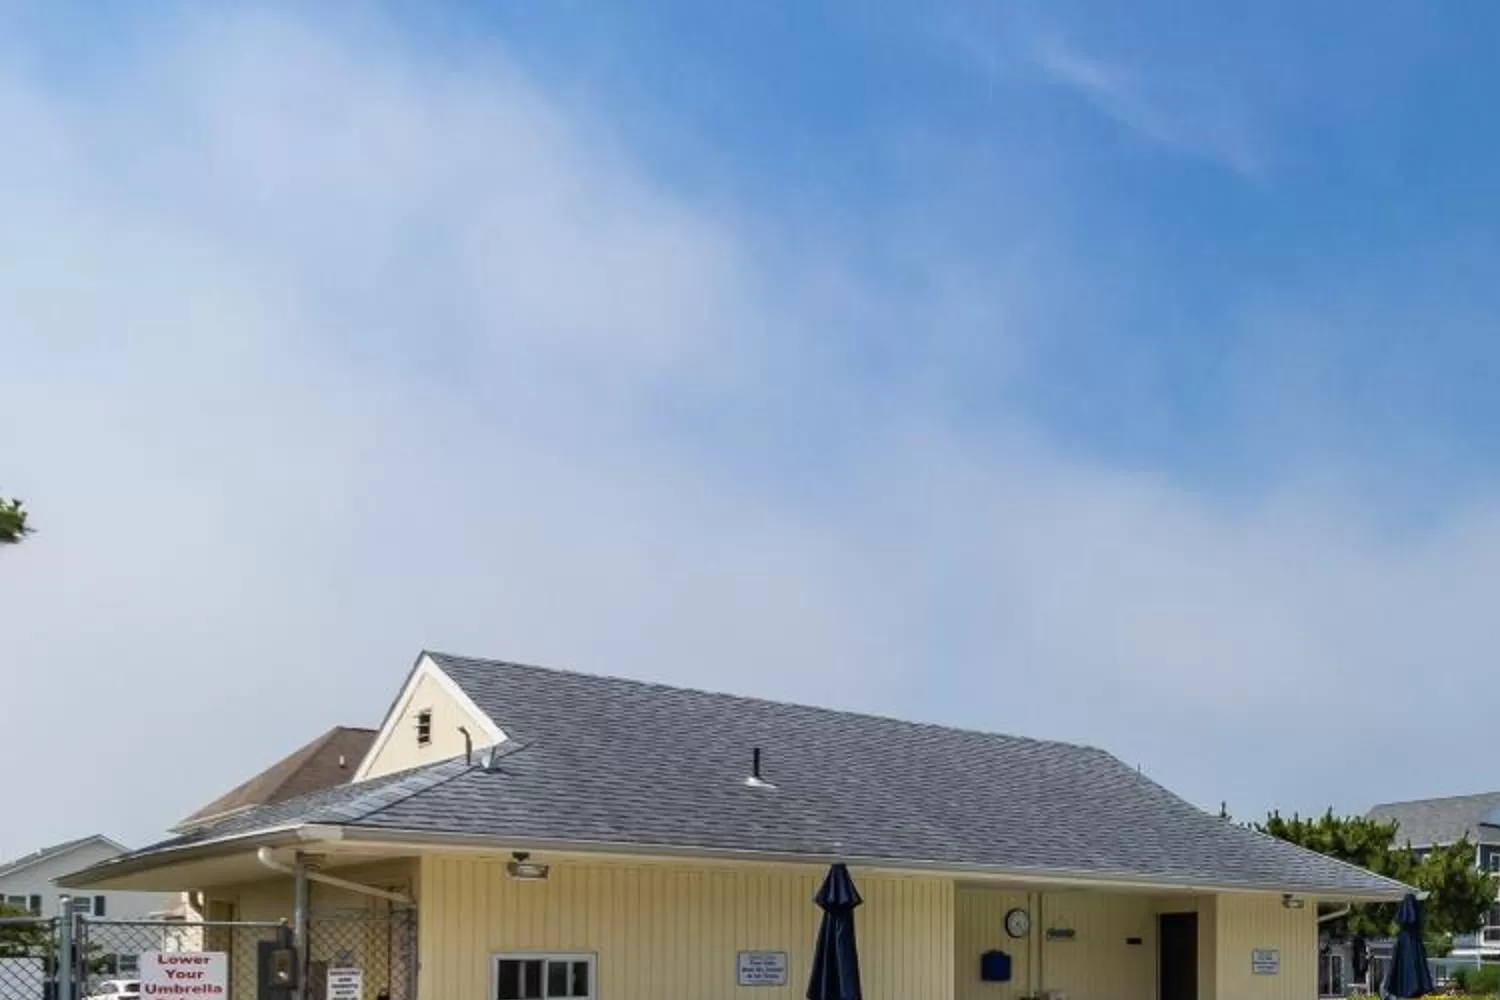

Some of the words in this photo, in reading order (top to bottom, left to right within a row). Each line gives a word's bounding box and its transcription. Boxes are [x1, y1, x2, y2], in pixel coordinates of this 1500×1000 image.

[157, 954, 211, 965] Lower
[165, 969, 205, 979] Your
[144, 984, 223, 994] Umbrella
